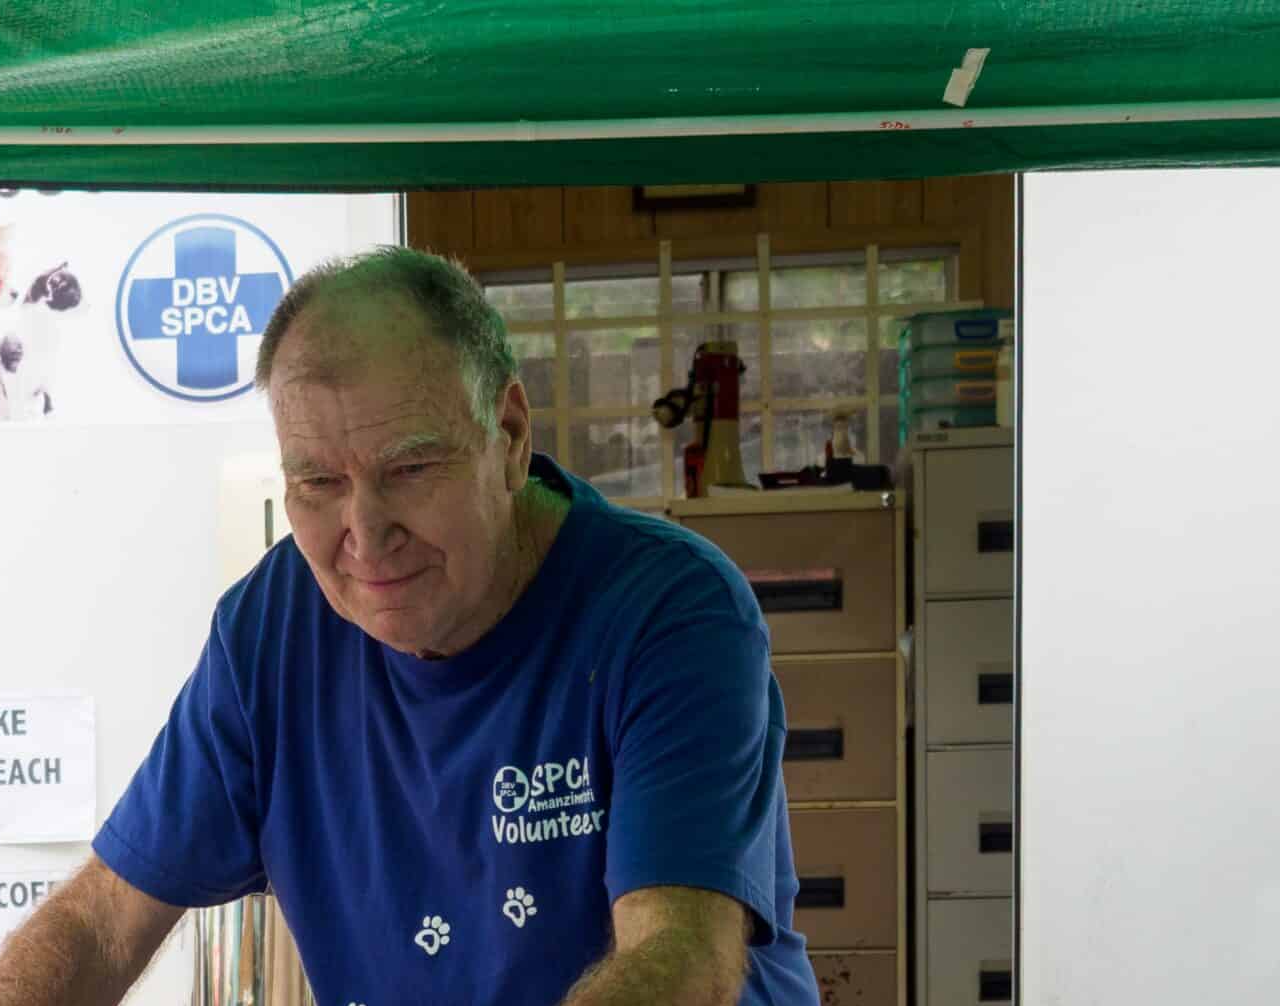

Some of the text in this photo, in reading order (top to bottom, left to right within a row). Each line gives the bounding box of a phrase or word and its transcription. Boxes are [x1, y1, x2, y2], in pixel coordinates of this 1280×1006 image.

[172, 276, 240, 306] DBV
[160, 304, 253, 337] SPCA
[530, 756, 590, 797] SPCA
[492, 809, 605, 843] Volunteer
